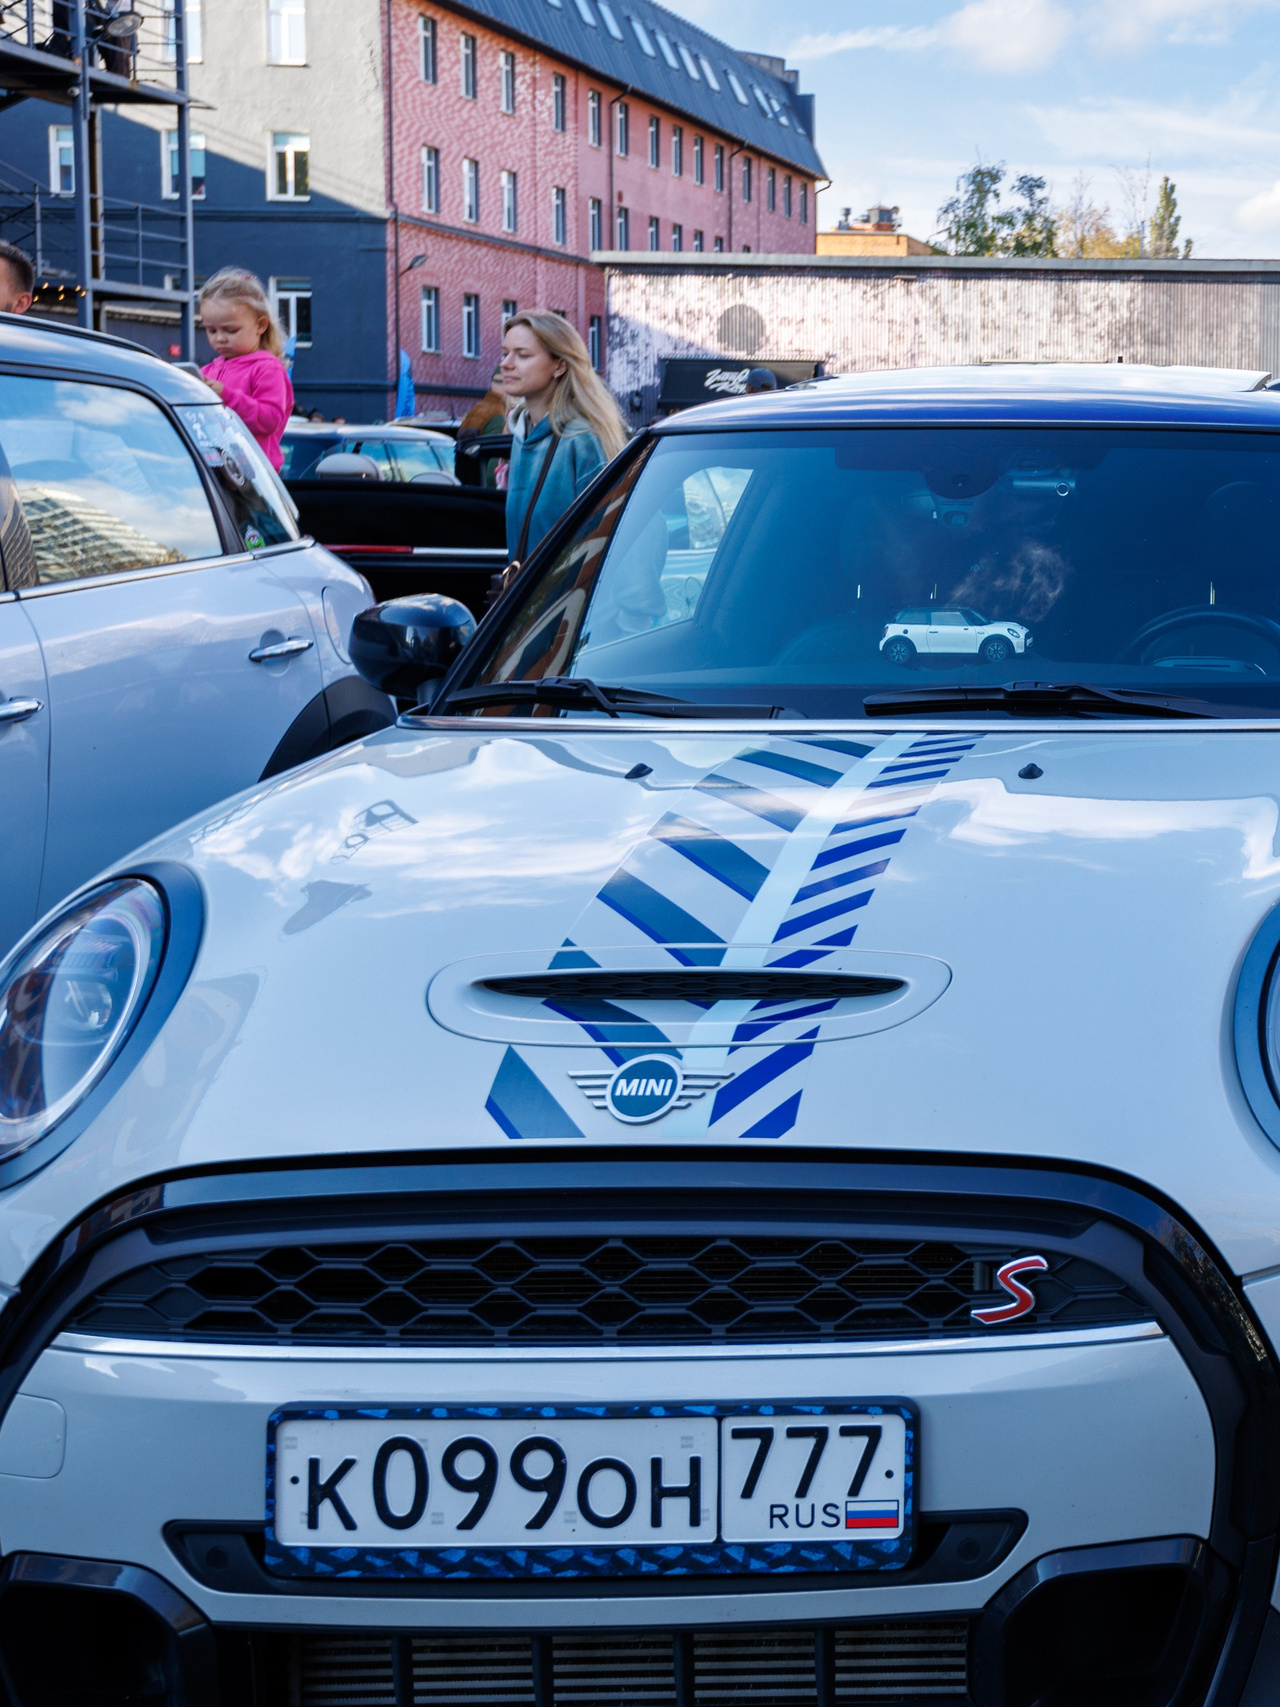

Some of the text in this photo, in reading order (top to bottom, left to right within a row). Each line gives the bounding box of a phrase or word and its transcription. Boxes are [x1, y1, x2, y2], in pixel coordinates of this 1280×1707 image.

[614, 1078, 673, 1096] MINI
[970, 1254, 1049, 1325] S
[730, 1424, 884, 1499] 777
[768, 1502, 842, 1530] RUS
